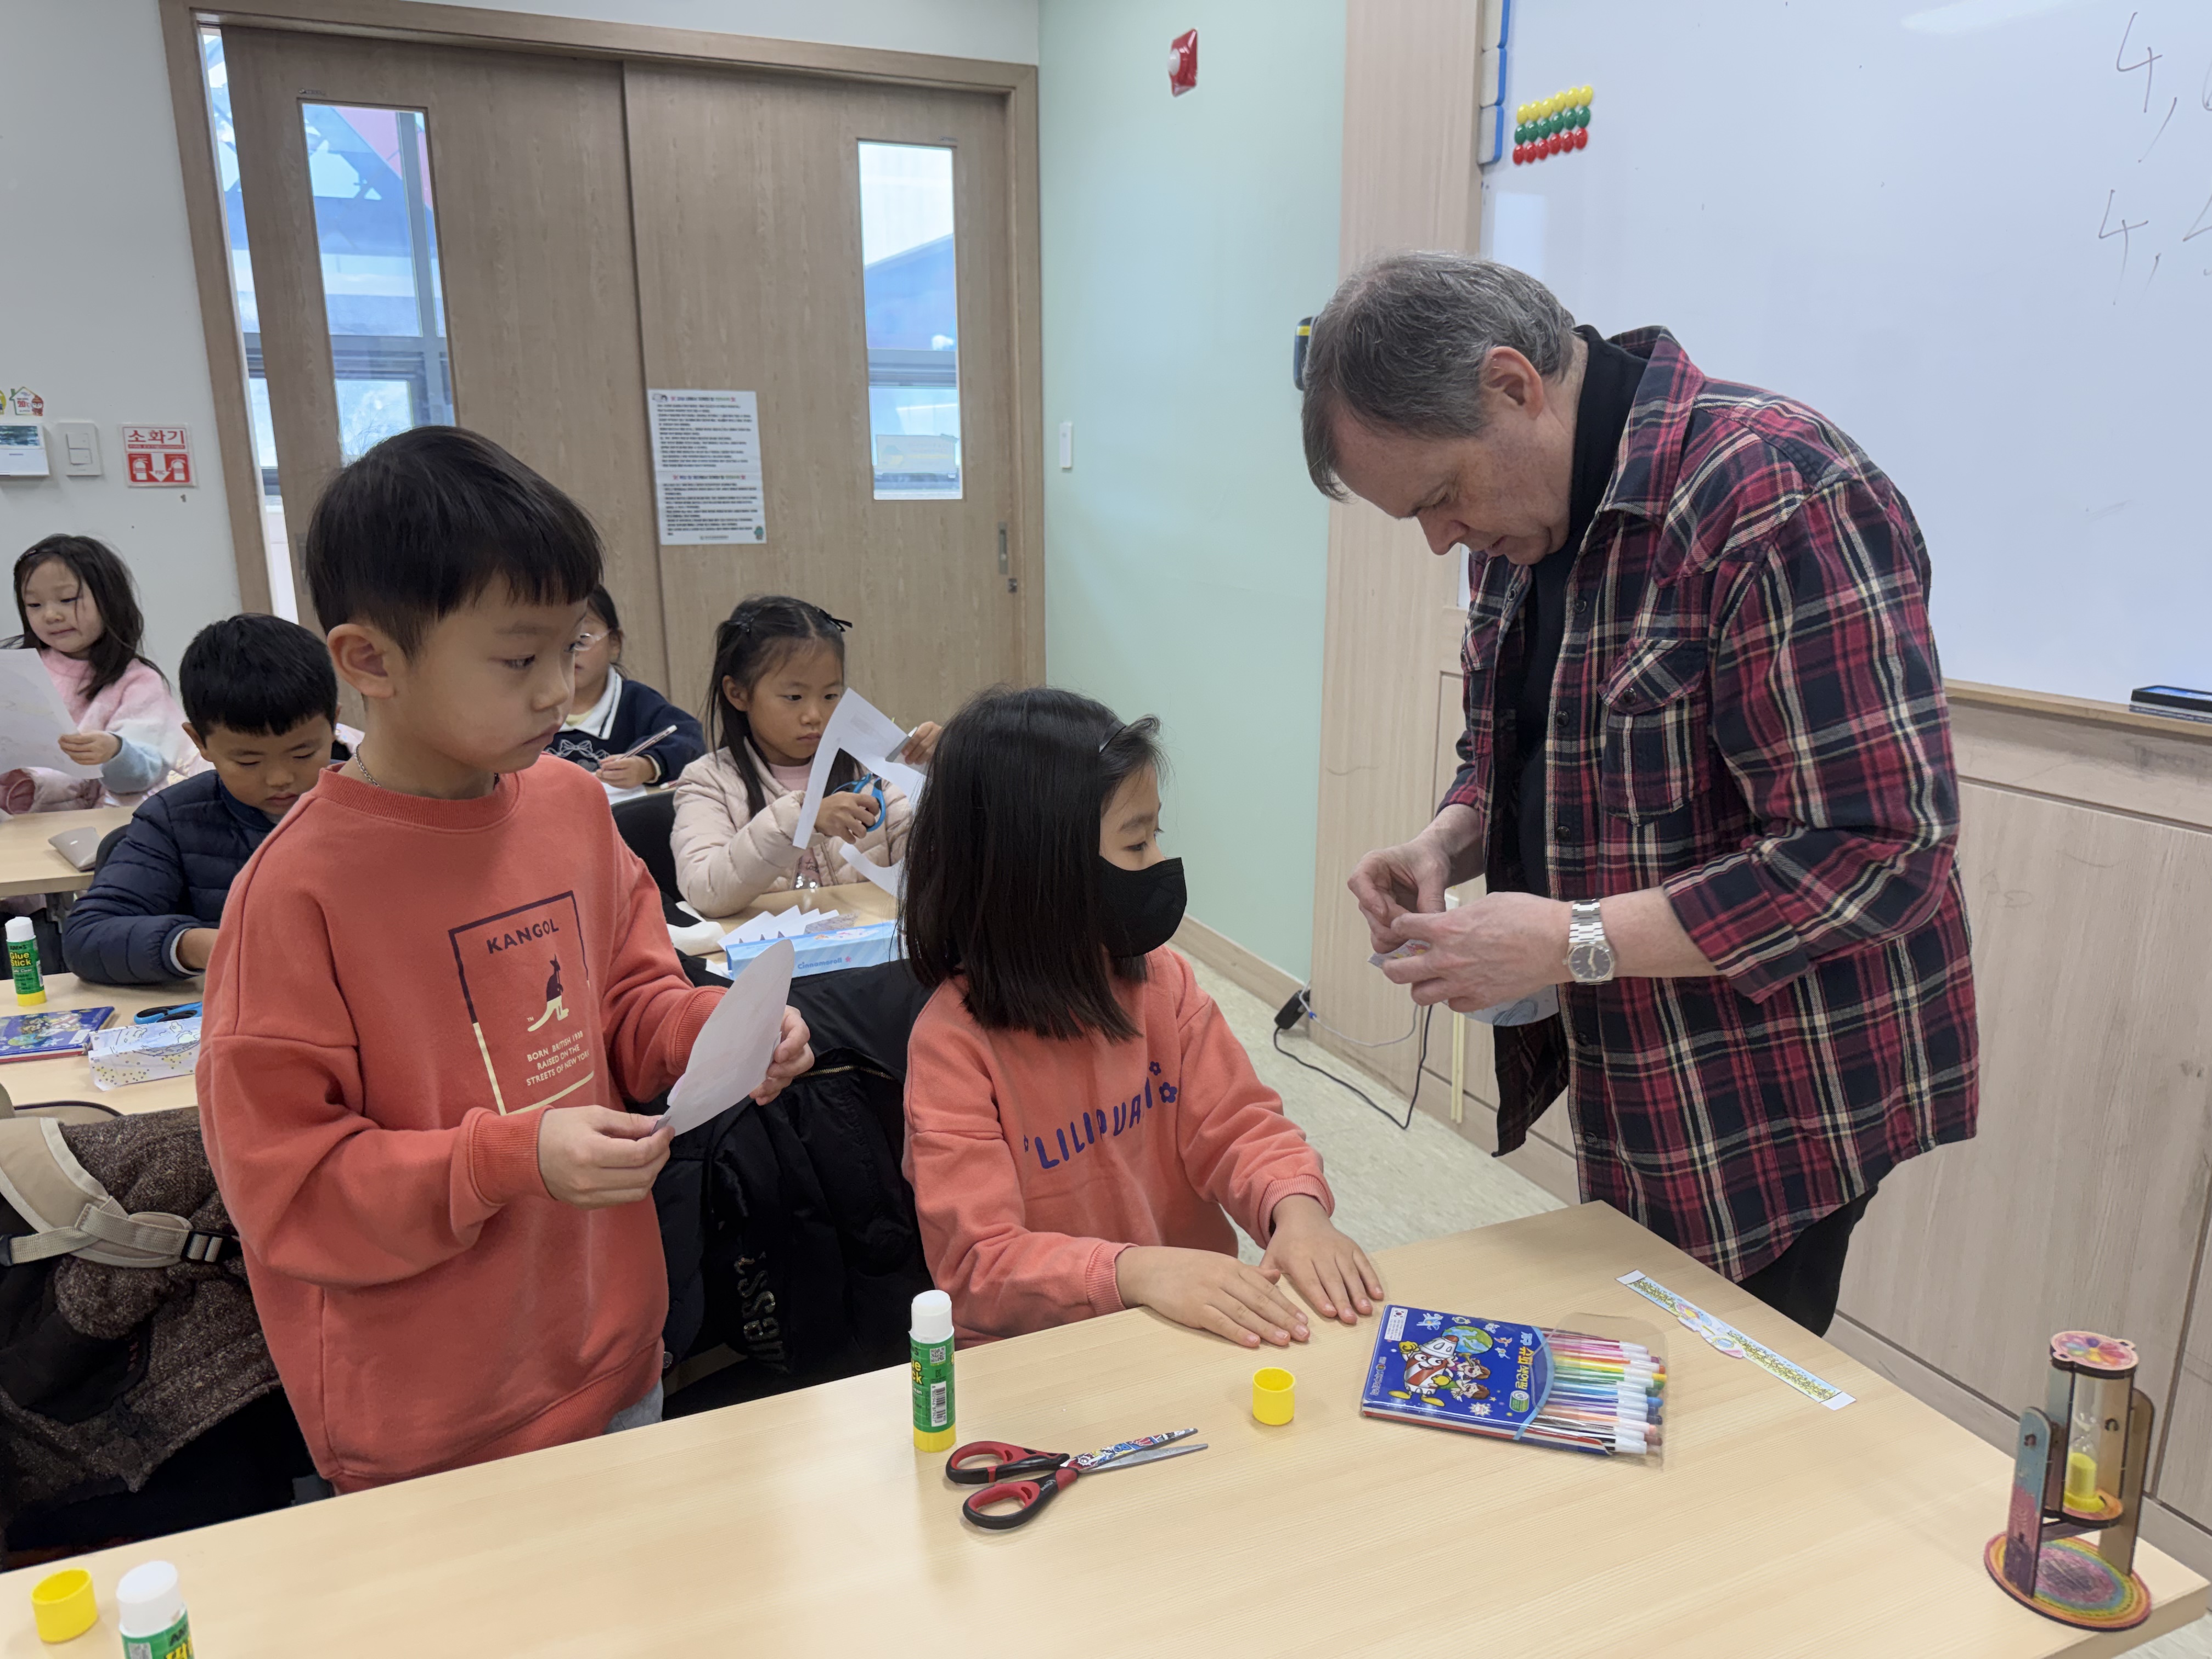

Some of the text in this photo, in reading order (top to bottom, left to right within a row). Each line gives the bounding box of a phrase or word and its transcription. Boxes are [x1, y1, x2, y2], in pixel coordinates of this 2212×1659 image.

[128, 430, 185, 444] 소화기
[486, 918, 559, 953] KANGOL
[10, 958, 31, 967] Stick
[798, 957, 842, 969] Cinnamoroll
[527, 1047, 549, 1062] BORN
[552, 1036, 571, 1052] BRITISH
[537, 1043, 580, 1070] RAISED ON THE
[526, 1068, 555, 1086] STREETS
[556, 1063, 564, 1074] OF
[564, 1056, 577, 1069] NEW
